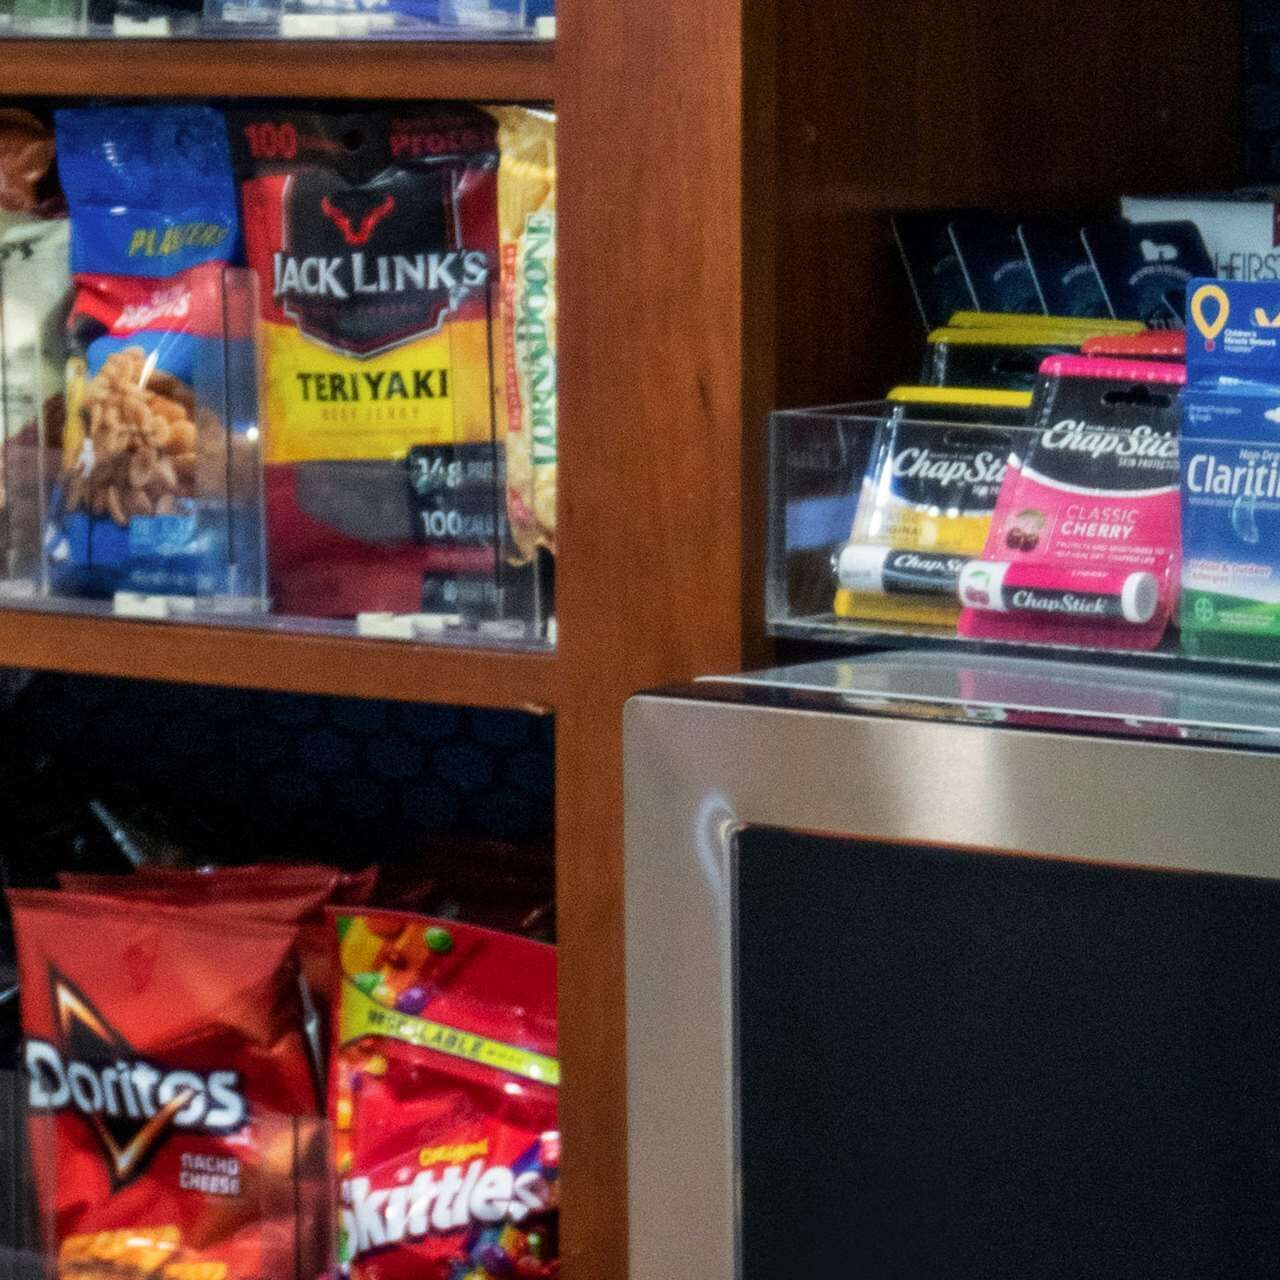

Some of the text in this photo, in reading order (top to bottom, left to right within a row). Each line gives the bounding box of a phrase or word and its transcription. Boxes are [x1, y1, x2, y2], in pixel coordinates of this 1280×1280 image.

[272, 248, 490, 298] JACK LINK'S
[516, 214, 554, 344] DOONE
[296, 367, 449, 404] TERIYAKI
[1041, 420, 1179, 460] ChapStic
[419, 509, 461, 537] 100
[1066, 504, 1139, 524] CLASSIC
[1060, 522, 1134, 540] CHERRY
[1012, 589, 1106, 614] ChapStick
[25, 1039, 248, 1134] Doritos
[180, 1153, 240, 1176] NACHO
[179, 1173, 241, 1195] CHEESE
